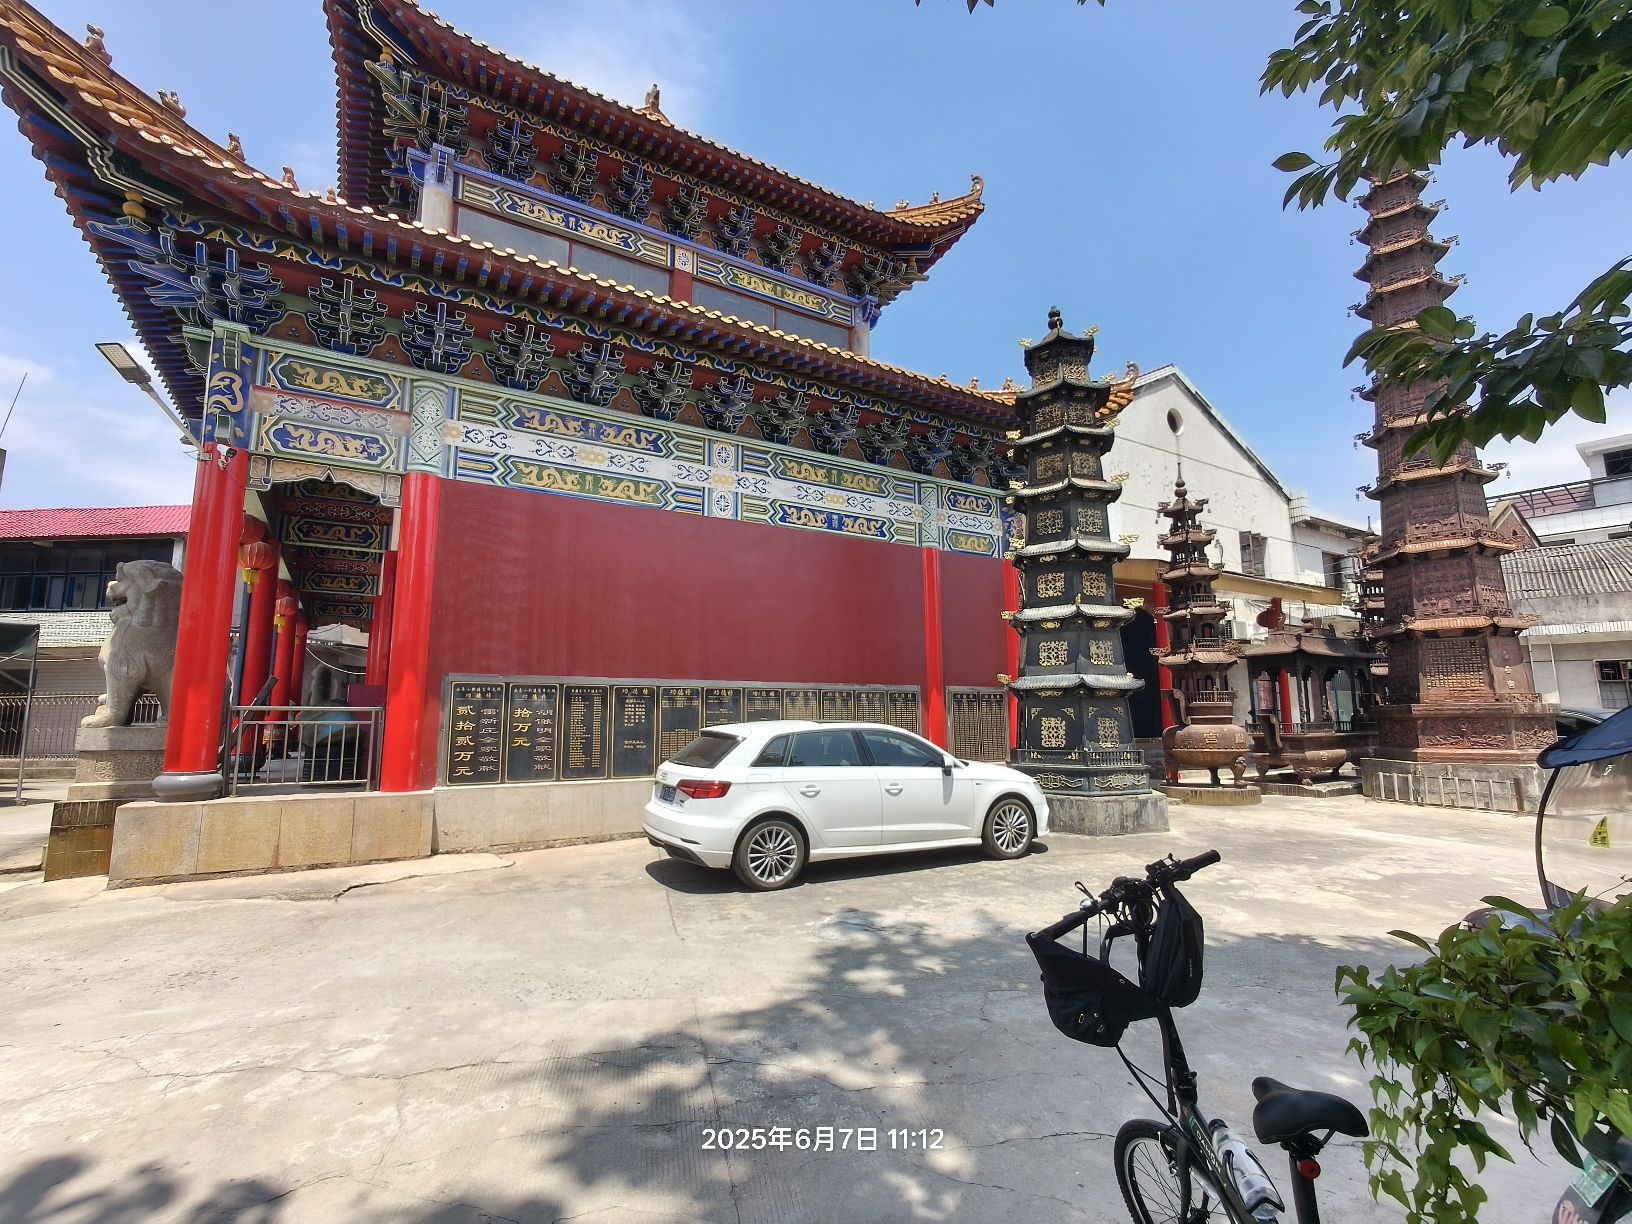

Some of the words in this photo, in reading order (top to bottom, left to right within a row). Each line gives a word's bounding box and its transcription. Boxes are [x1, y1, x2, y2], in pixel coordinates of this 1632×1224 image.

[453, 705, 476, 777] 贰拾贰万元
[511, 707, 534, 748] 拾万元
